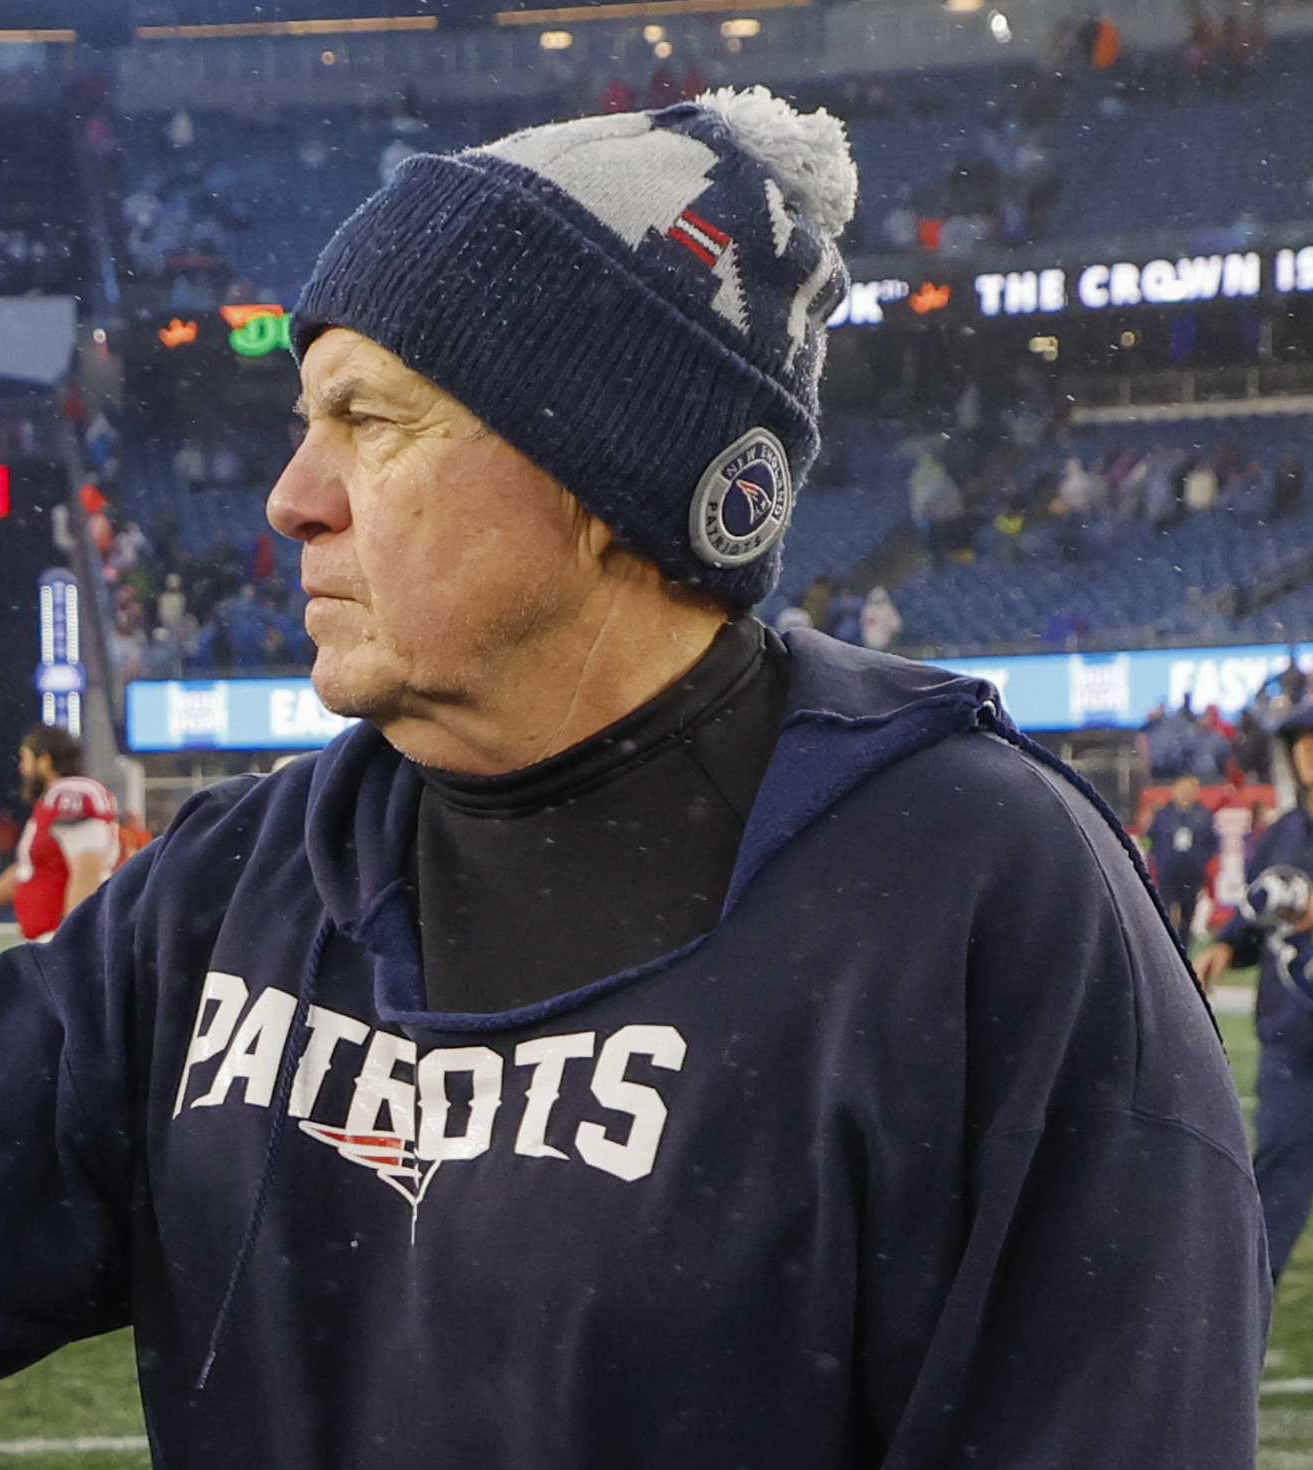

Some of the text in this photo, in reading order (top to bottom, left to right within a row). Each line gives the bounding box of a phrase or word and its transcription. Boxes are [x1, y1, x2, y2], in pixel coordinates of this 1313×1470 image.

[974, 268, 1066, 318] THE
[1079, 252, 1261, 310] CROWN
[726, 444, 785, 516] NEW ENGLAND
[705, 501, 762, 555] PATRIOTS
[173, 970, 687, 1182] PATROTS
